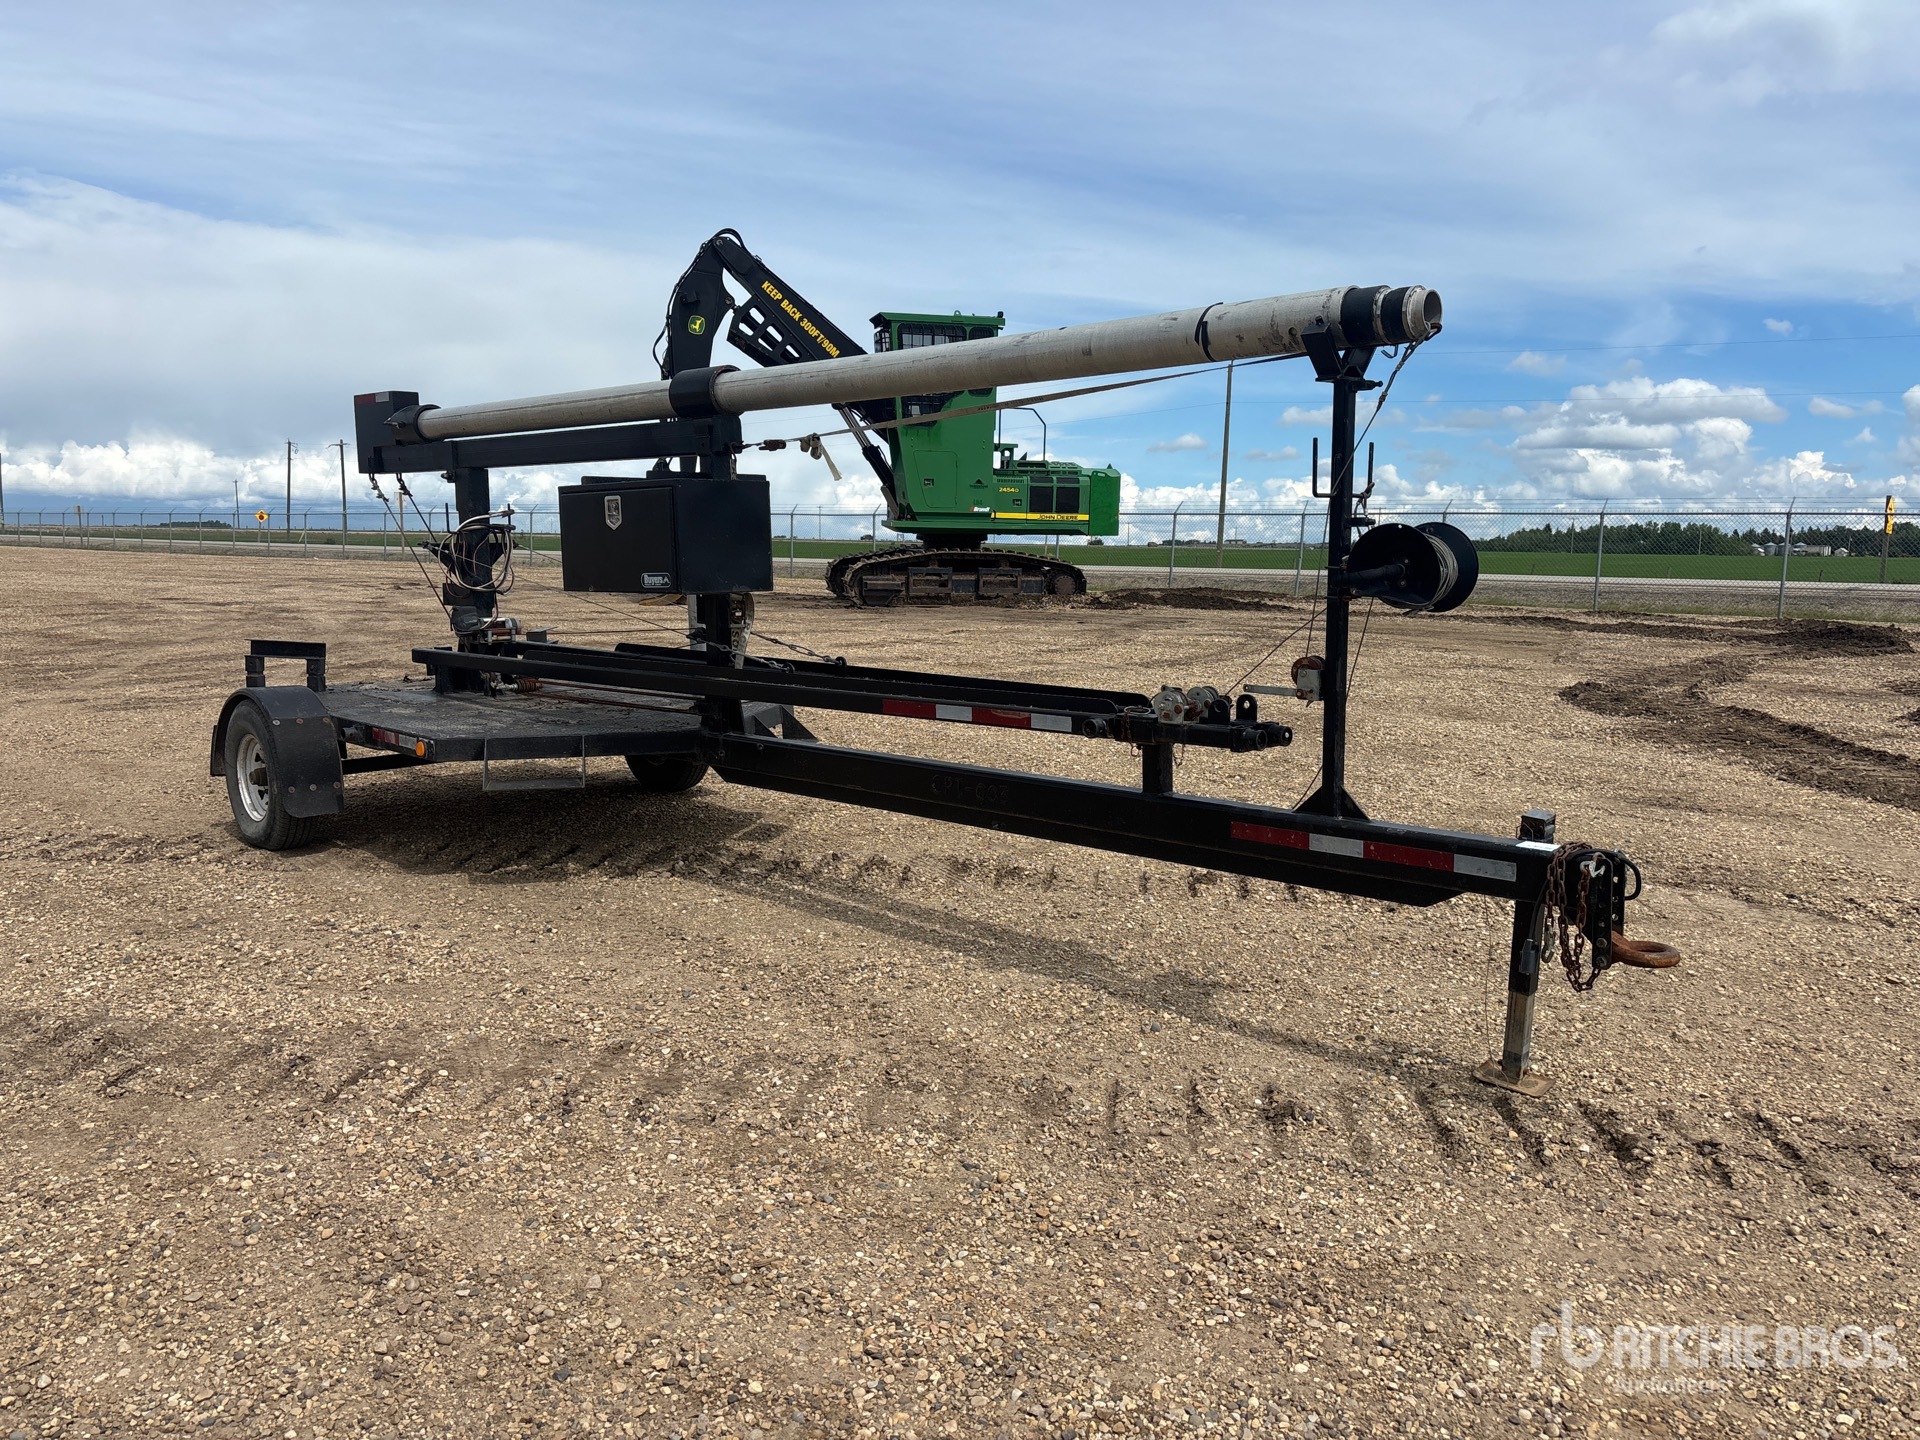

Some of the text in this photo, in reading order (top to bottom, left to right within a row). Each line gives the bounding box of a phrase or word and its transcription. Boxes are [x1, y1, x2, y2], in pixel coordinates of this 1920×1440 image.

[761, 280, 841, 358] KEEP BACK 300FT/90M
